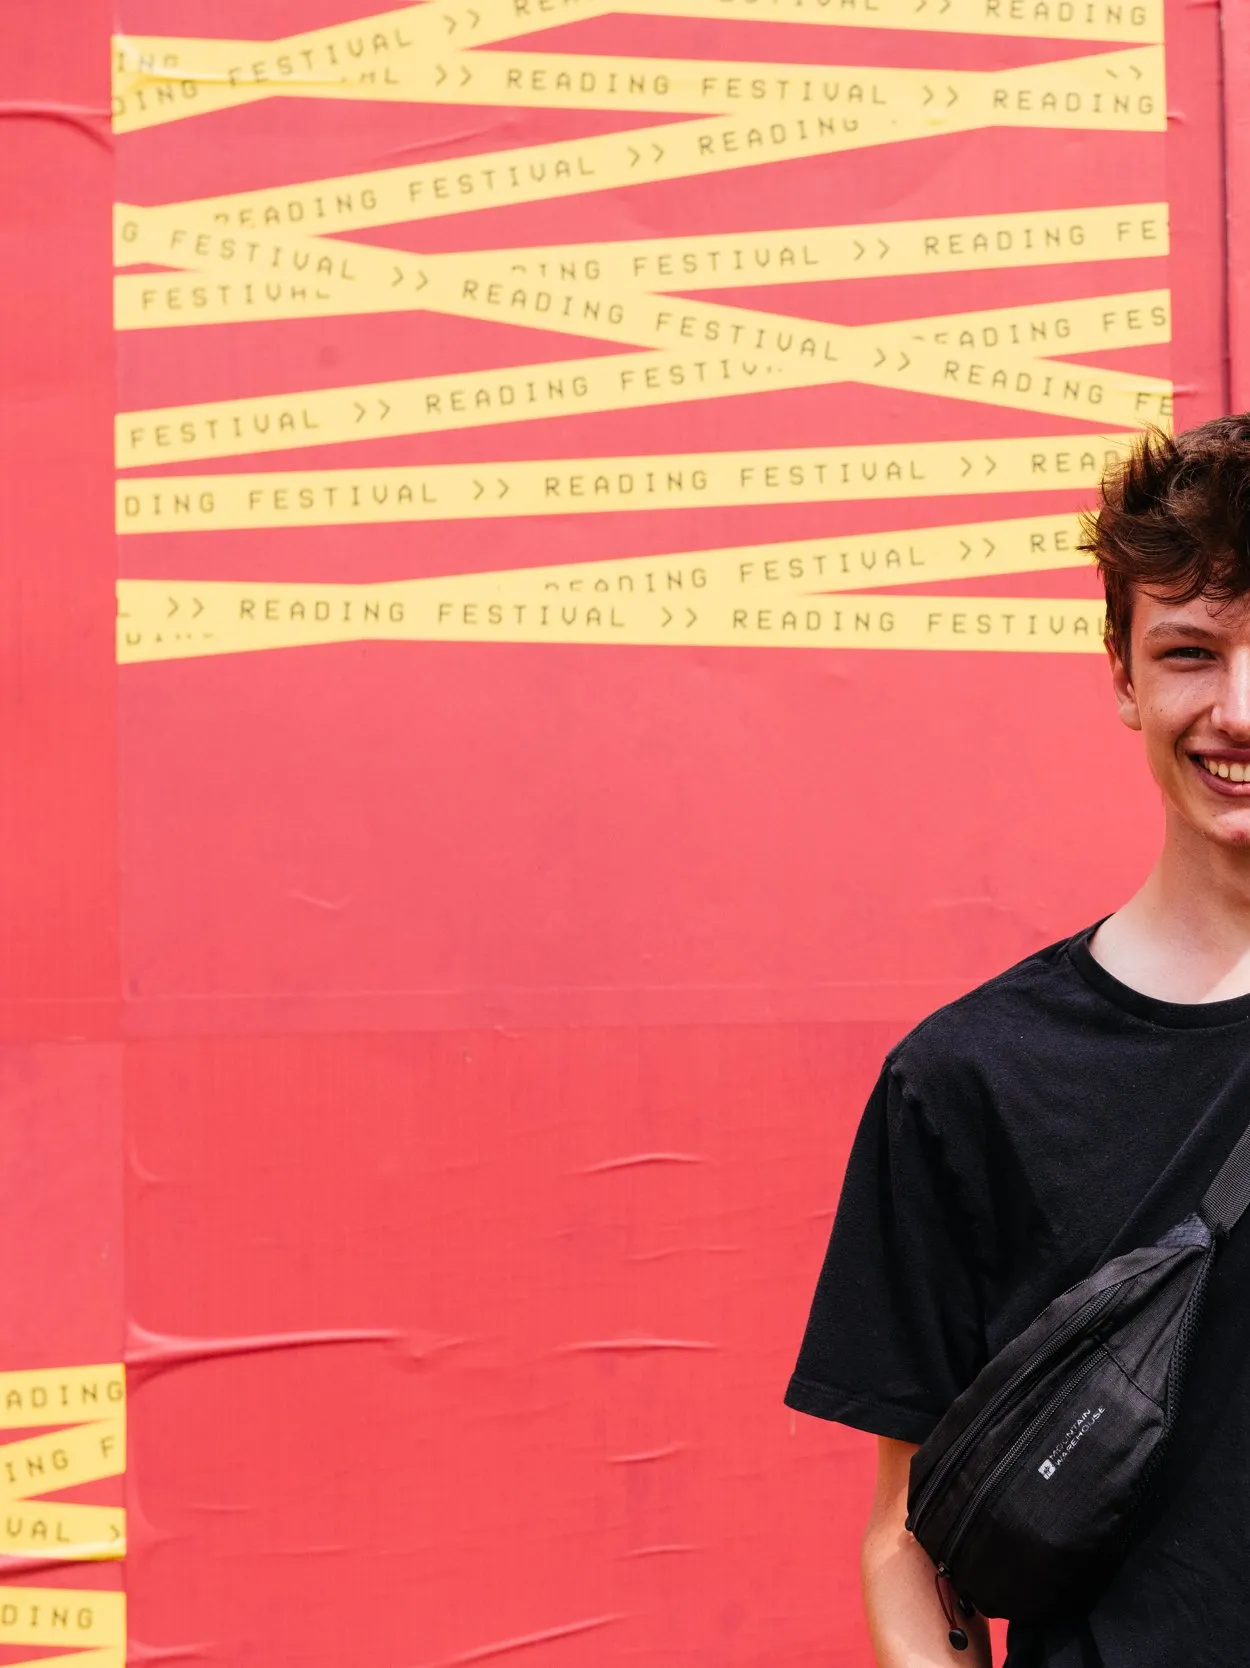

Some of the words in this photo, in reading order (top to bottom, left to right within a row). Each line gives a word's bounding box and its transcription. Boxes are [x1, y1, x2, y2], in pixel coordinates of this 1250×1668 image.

[986, 0, 1147, 26] READING
[227, 28, 413, 86] FESTIVAL
[507, 69, 669, 95] READING
[702, 78, 886, 104] FESTIVAL
[993, 89, 1153, 114] READING
[409, 157, 594, 202] FESTIVAL
[634, 246, 818, 276] FESTIVAL
[925, 225, 1084, 255] READING
[171, 230, 353, 280] FESTIVAL
[462, 280, 623, 324] READING
[656, 312, 837, 361] FESTIVAL
[944, 360, 1103, 404] READING
[131, 410, 318, 448] FESTIVAL
[426, 376, 588, 414] READING
[249, 483, 436, 510] FESTIVAL
[545, 470, 707, 496] READING
[740, 461, 925, 487] FESTIVAL
[740, 547, 924, 583] FESTIVAL
[240, 599, 404, 622] READING
[438, 603, 624, 627] FESTIVAL
[733, 609, 894, 632] READING
